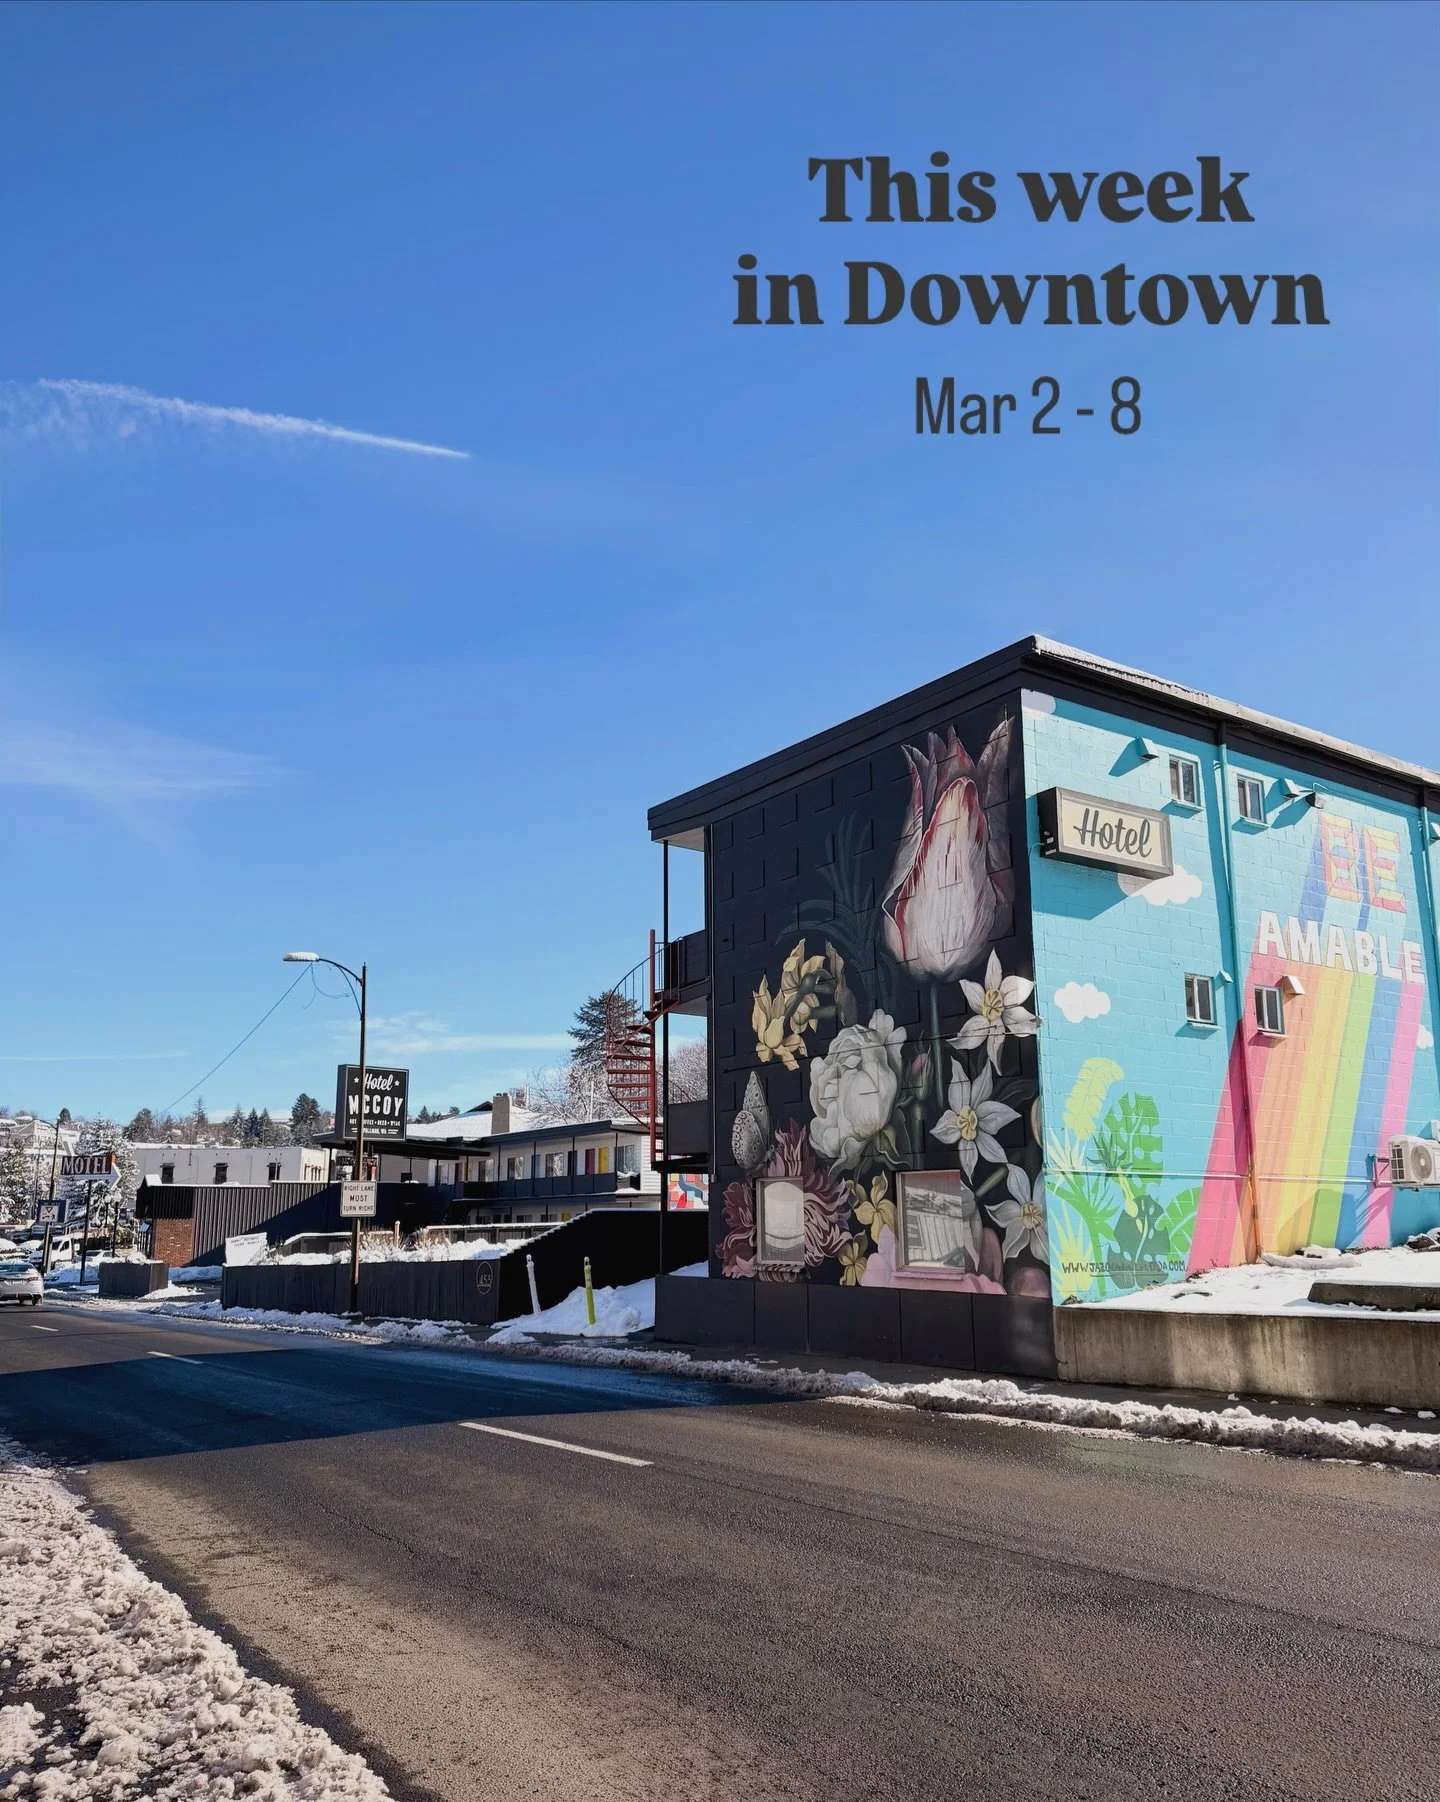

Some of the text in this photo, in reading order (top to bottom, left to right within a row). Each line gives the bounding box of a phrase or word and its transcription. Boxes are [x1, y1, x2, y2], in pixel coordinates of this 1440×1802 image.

[1073, 807, 1153, 858] Hotel
[1317, 811, 1407, 914] BE
[1257, 910, 1427, 985] AMABLE
[364, 1073, 394, 1091] Hotel
[62, 1157, 110, 1175] MOTEL
[349, 1194, 368, 1202] MUST
